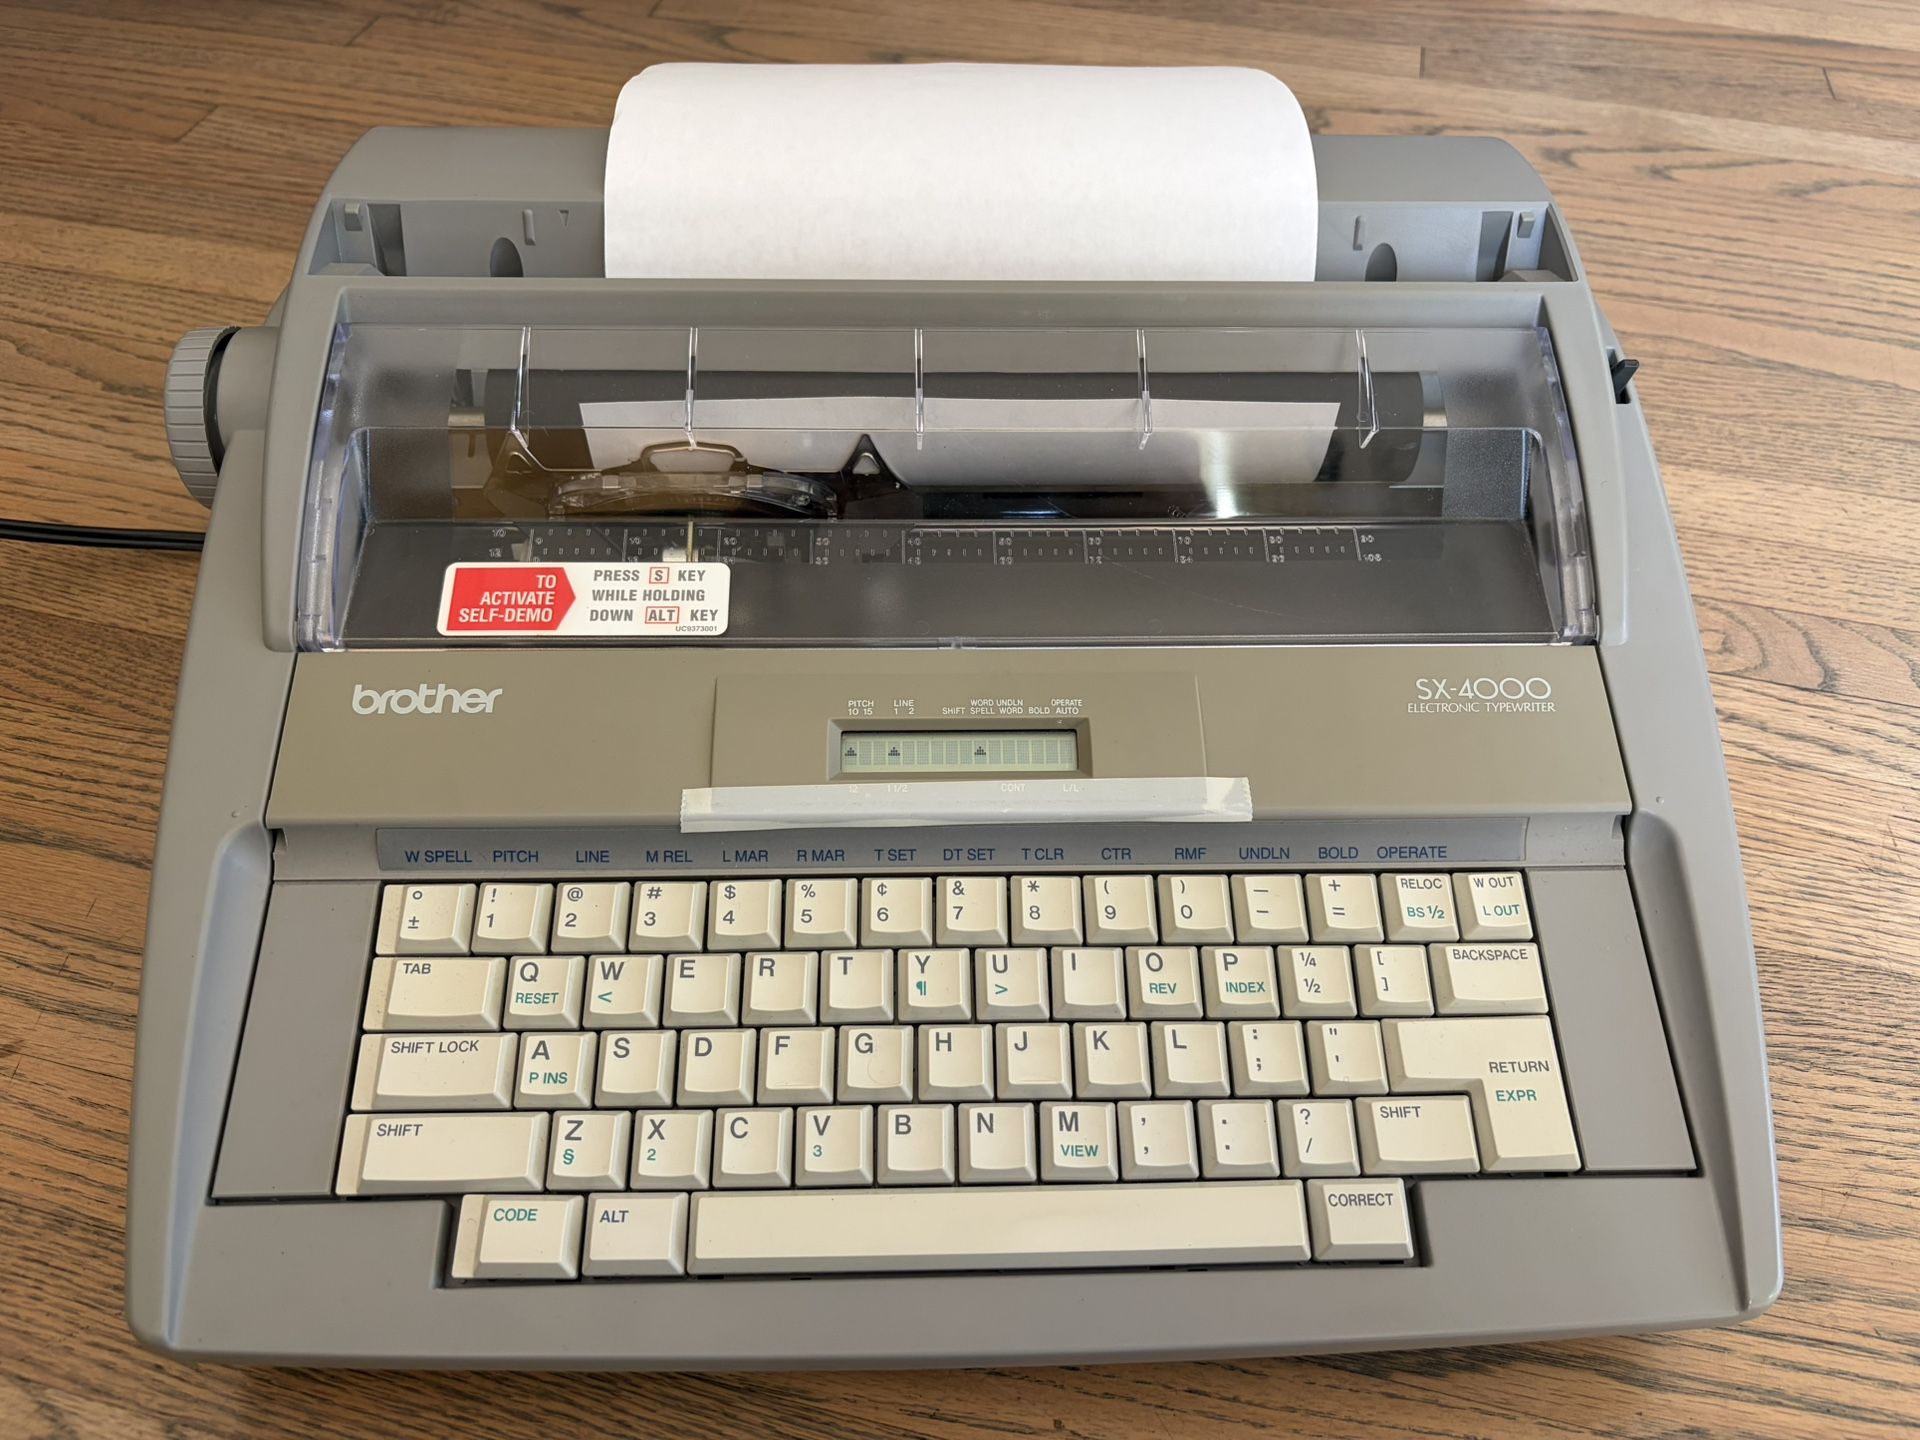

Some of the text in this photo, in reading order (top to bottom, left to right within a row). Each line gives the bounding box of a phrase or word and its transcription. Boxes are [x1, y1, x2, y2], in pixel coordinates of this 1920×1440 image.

[536, 575, 556, 588] TO
[593, 570, 706, 581] PRESS S KEY
[480, 592, 555, 605] ACTIVATE
[592, 590, 705, 601] WHILE HOLDING
[459, 608, 552, 622] SELF-DEMO
[589, 609, 718, 621] DOWN ALT KEY
[1416, 677, 1551, 700] SX-4000
[352, 683, 503, 715] brother
[848, 708, 858, 716] 10
[942, 707, 965, 715] SHIFT
[970, 707, 995, 715] SPELL
[1408, 702, 1556, 712] ELECTRONIC TYPEWRITER
[1001, 784, 1025, 792] CONT
[405, 851, 472, 862] W SPELL
[493, 851, 539, 862] PITCH
[576, 851, 610, 862] LINE
[646, 851, 693, 862] M REL
[723, 850, 768, 862] L MAR
[797, 850, 845, 861] R MAR
[874, 849, 917, 861] T SET
[943, 849, 995, 860] DT SET
[1021, 848, 1064, 860] T CLR
[1101, 848, 1131, 860] CTR
[1174, 848, 1206, 859] RMF
[1239, 848, 1290, 859] UNDLN
[1318, 847, 1358, 858] BOLD
[1377, 846, 1447, 858] OPERATE
[952, 881, 965, 896] &
[1104, 880, 1109, 894] (
[1180, 880, 1185, 894] )
[1328, 880, 1341, 892] +
[1400, 878, 1442, 890] RELOC
[1474, 876, 1514, 888] W OUT
[491, 888, 497, 902] !
[567, 887, 583, 901] @
[647, 887, 662, 899] #
[724, 885, 736, 900] $
[801, 884, 816, 898] %
[801, 909, 812, 923] 5
[877, 907, 889, 922] 6
[953, 906, 964, 920] 7
[1029, 906, 1040, 920] 8
[1104, 905, 1116, 920] 9
[1332, 907, 1345, 916] =
[1407, 907, 1424, 918] BS
[1484, 904, 1520, 916] L OUT
[408, 916, 419, 929] ±
[486, 914, 494, 927] 1
[565, 913, 577, 927] 2
[644, 912, 656, 926] 3
[723, 910, 735, 925] 4
[1376, 951, 1384, 965] [
[1453, 949, 1528, 960] BACKSPACE
[759, 958, 776, 977] R
[837, 957, 853, 975] T
[915, 955, 931, 974] Y
[992, 955, 1008, 973] U
[1071, 953, 1076, 970] I
[1145, 953, 1163, 972] O
[1222, 953, 1238, 971] P
[403, 963, 432, 974] TAB
[519, 962, 539, 983] Q
[600, 962, 625, 980] W
[680, 960, 695, 978] E
[1149, 983, 1176, 993] REV
[1226, 982, 1264, 993] INDEX
[1382, 977, 1389, 991] ]
[515, 992, 559, 1004] RESET
[775, 1036, 790, 1055] F
[855, 1033, 873, 1053] G
[935, 1032, 951, 1052] H
[1014, 1031, 1027, 1051] J
[1093, 1030, 1110, 1050] K
[1172, 1029, 1187, 1049] L
[391, 1040, 479, 1053] SHIFT LOCK
[531, 1040, 550, 1060] A
[613, 1037, 631, 1058] S
[694, 1037, 713, 1056] D
[1489, 1060, 1550, 1073] RETURN
[529, 1072, 568, 1084] P INS
[1496, 1090, 1537, 1102] EXPR
[1300, 1108, 1311, 1125] ?
[1380, 1106, 1421, 1119] SHIFT
[730, 1117, 748, 1138] C
[813, 1115, 831, 1135] V
[895, 1115, 912, 1135] B
[977, 1113, 994, 1133] N
[1059, 1111, 1079, 1132] M
[376, 1123, 423, 1136] SHIFT
[564, 1120, 584, 1140] Z
[647, 1119, 666, 1140] X
[647, 1149, 656, 1161] 2
[813, 1145, 822, 1157] 3
[1060, 1145, 1098, 1157] VIEW
[1328, 1193, 1393, 1206] CORRECT
[494, 1208, 538, 1222] CODE
[600, 1210, 629, 1222] ALT
